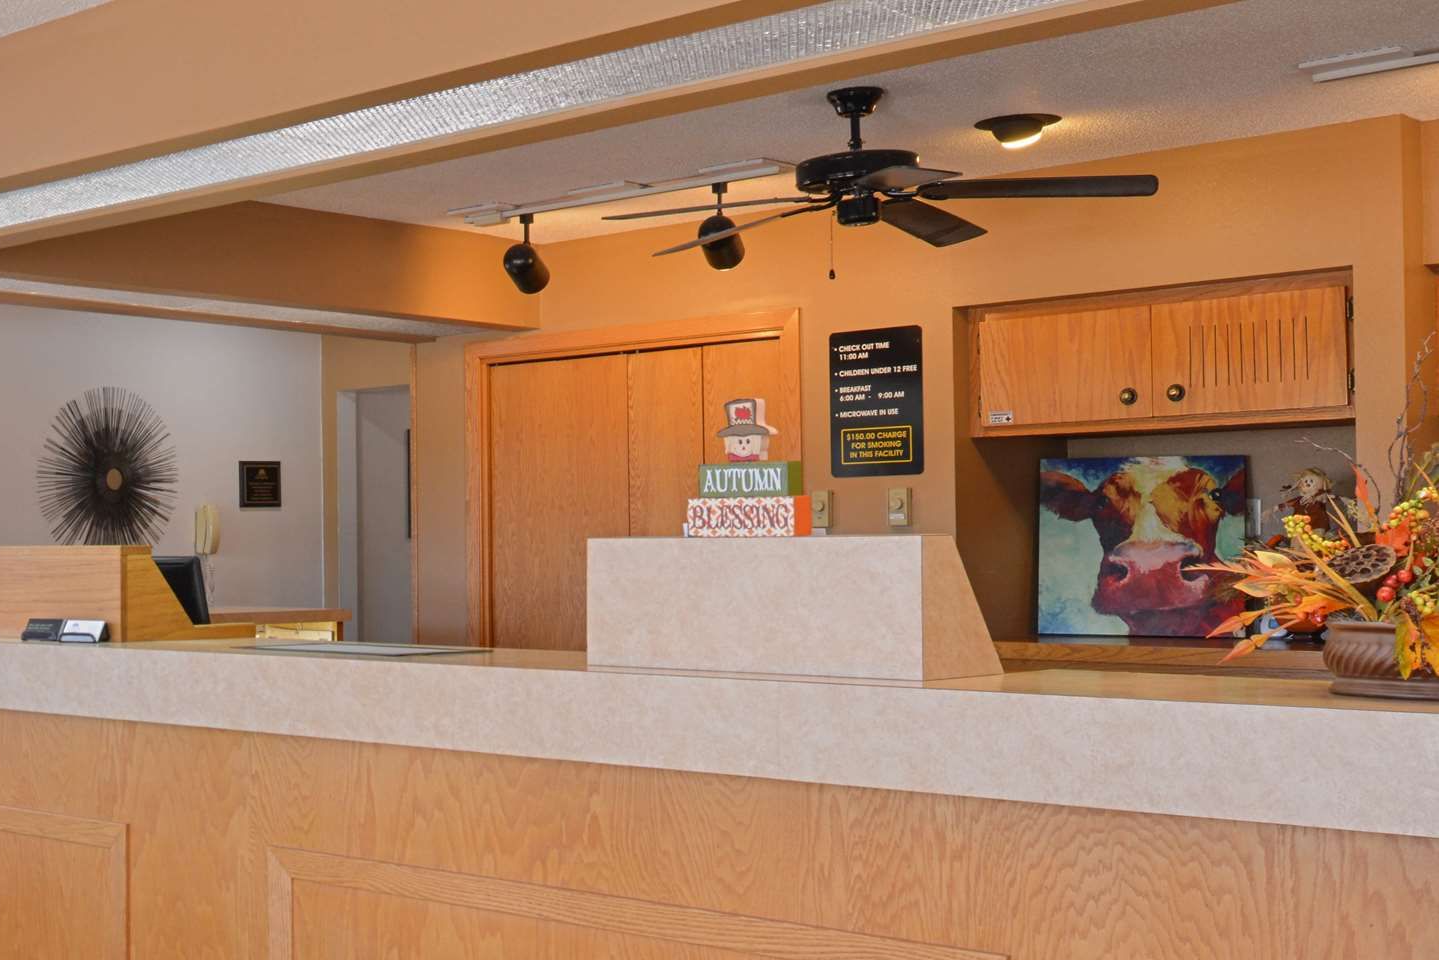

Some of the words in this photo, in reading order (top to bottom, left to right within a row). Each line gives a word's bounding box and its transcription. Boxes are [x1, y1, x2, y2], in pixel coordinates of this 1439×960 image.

[875, 341, 890, 349] TIME
[839, 368, 869, 377] CHILDREN
[871, 367, 891, 375] UNDER
[902, 364, 917, 372] FREE
[840, 385, 871, 393] BREAKFAST
[840, 409, 877, 418] MICROWAVE
[846, 432, 875, 441] $150.00
[877, 431, 907, 439] CHARGE
[703, 467, 782, 493] AUTUMN
[692, 504, 789, 529] BLESSING
